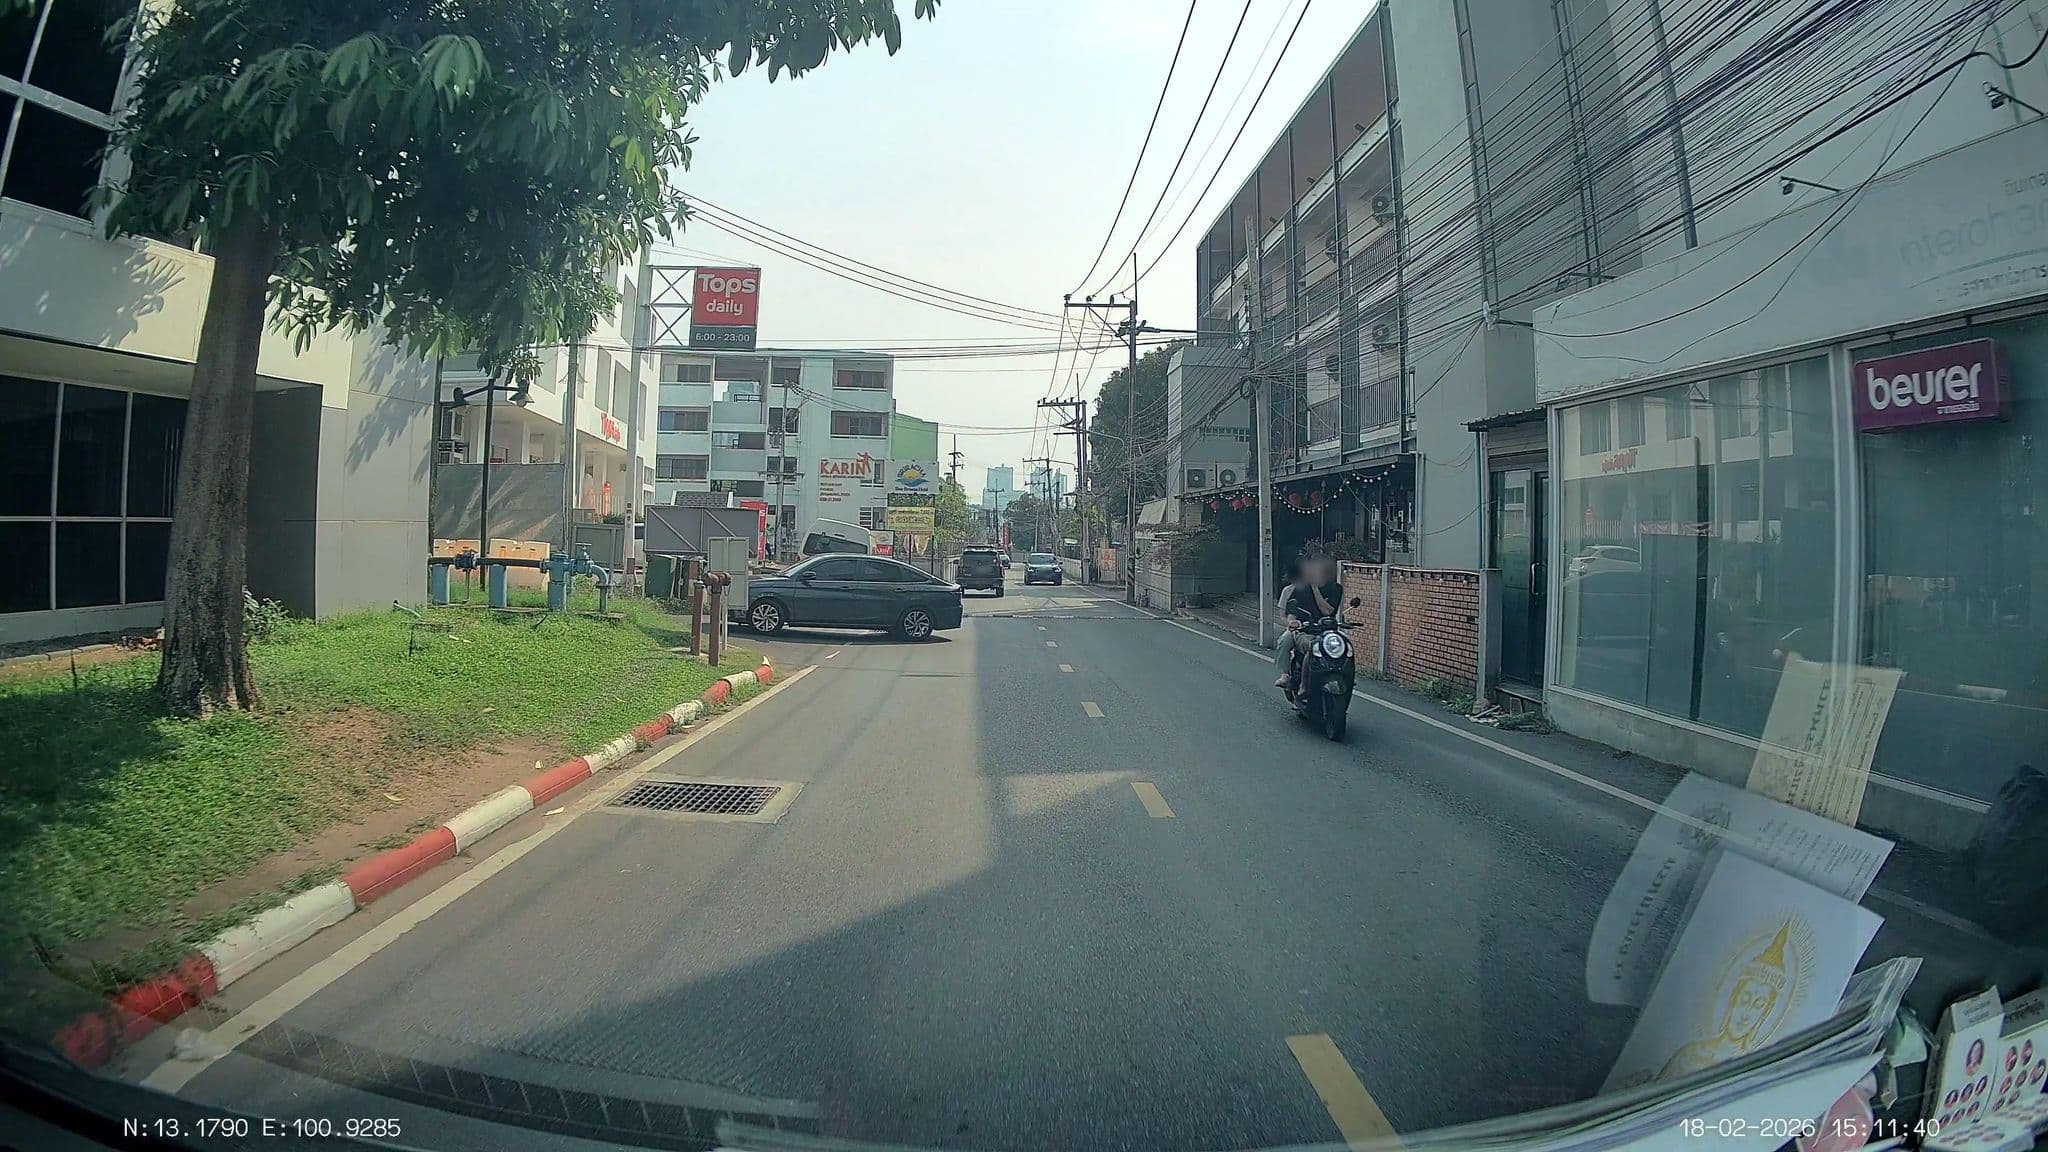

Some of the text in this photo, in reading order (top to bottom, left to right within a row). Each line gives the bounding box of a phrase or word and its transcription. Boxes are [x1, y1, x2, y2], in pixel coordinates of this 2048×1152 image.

[698, 274, 756, 298] Tops
[706, 299, 744, 316] daily
[696, 333, 716, 342] 6:00
[724, 333, 750, 342] 23:00
[1866, 361, 1982, 411] beurer
[820, 461, 866, 475] KARIN
